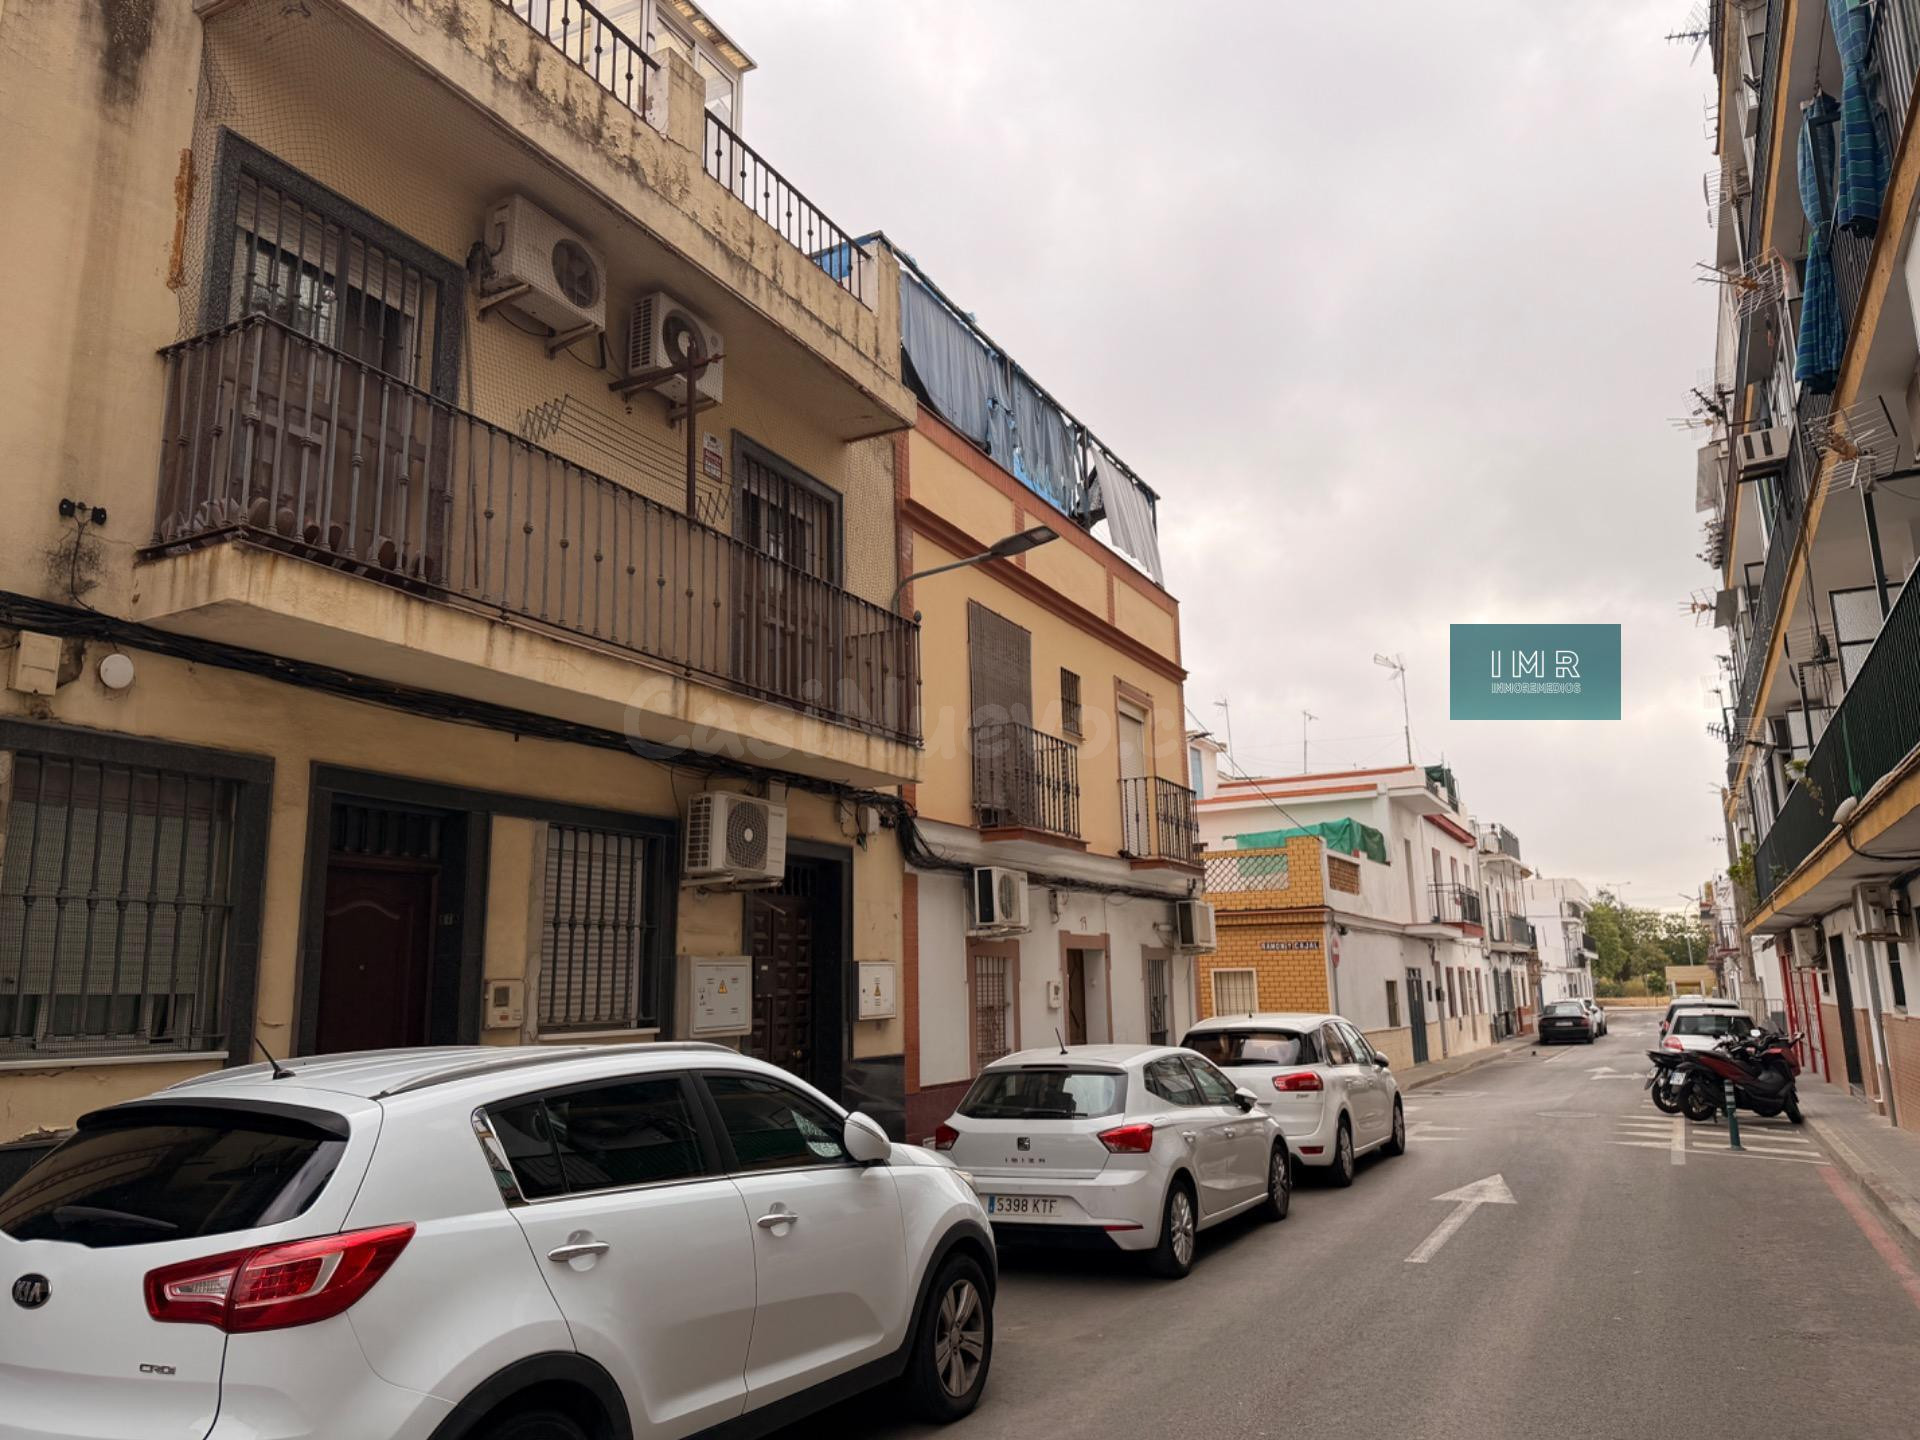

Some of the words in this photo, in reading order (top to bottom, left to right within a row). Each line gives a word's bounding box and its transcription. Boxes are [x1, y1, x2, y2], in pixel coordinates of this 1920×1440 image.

[997, 1197, 1028, 1213] 5398
[1032, 1199, 1057, 1214] KTF
[14, 1280, 41, 1303] KIA
